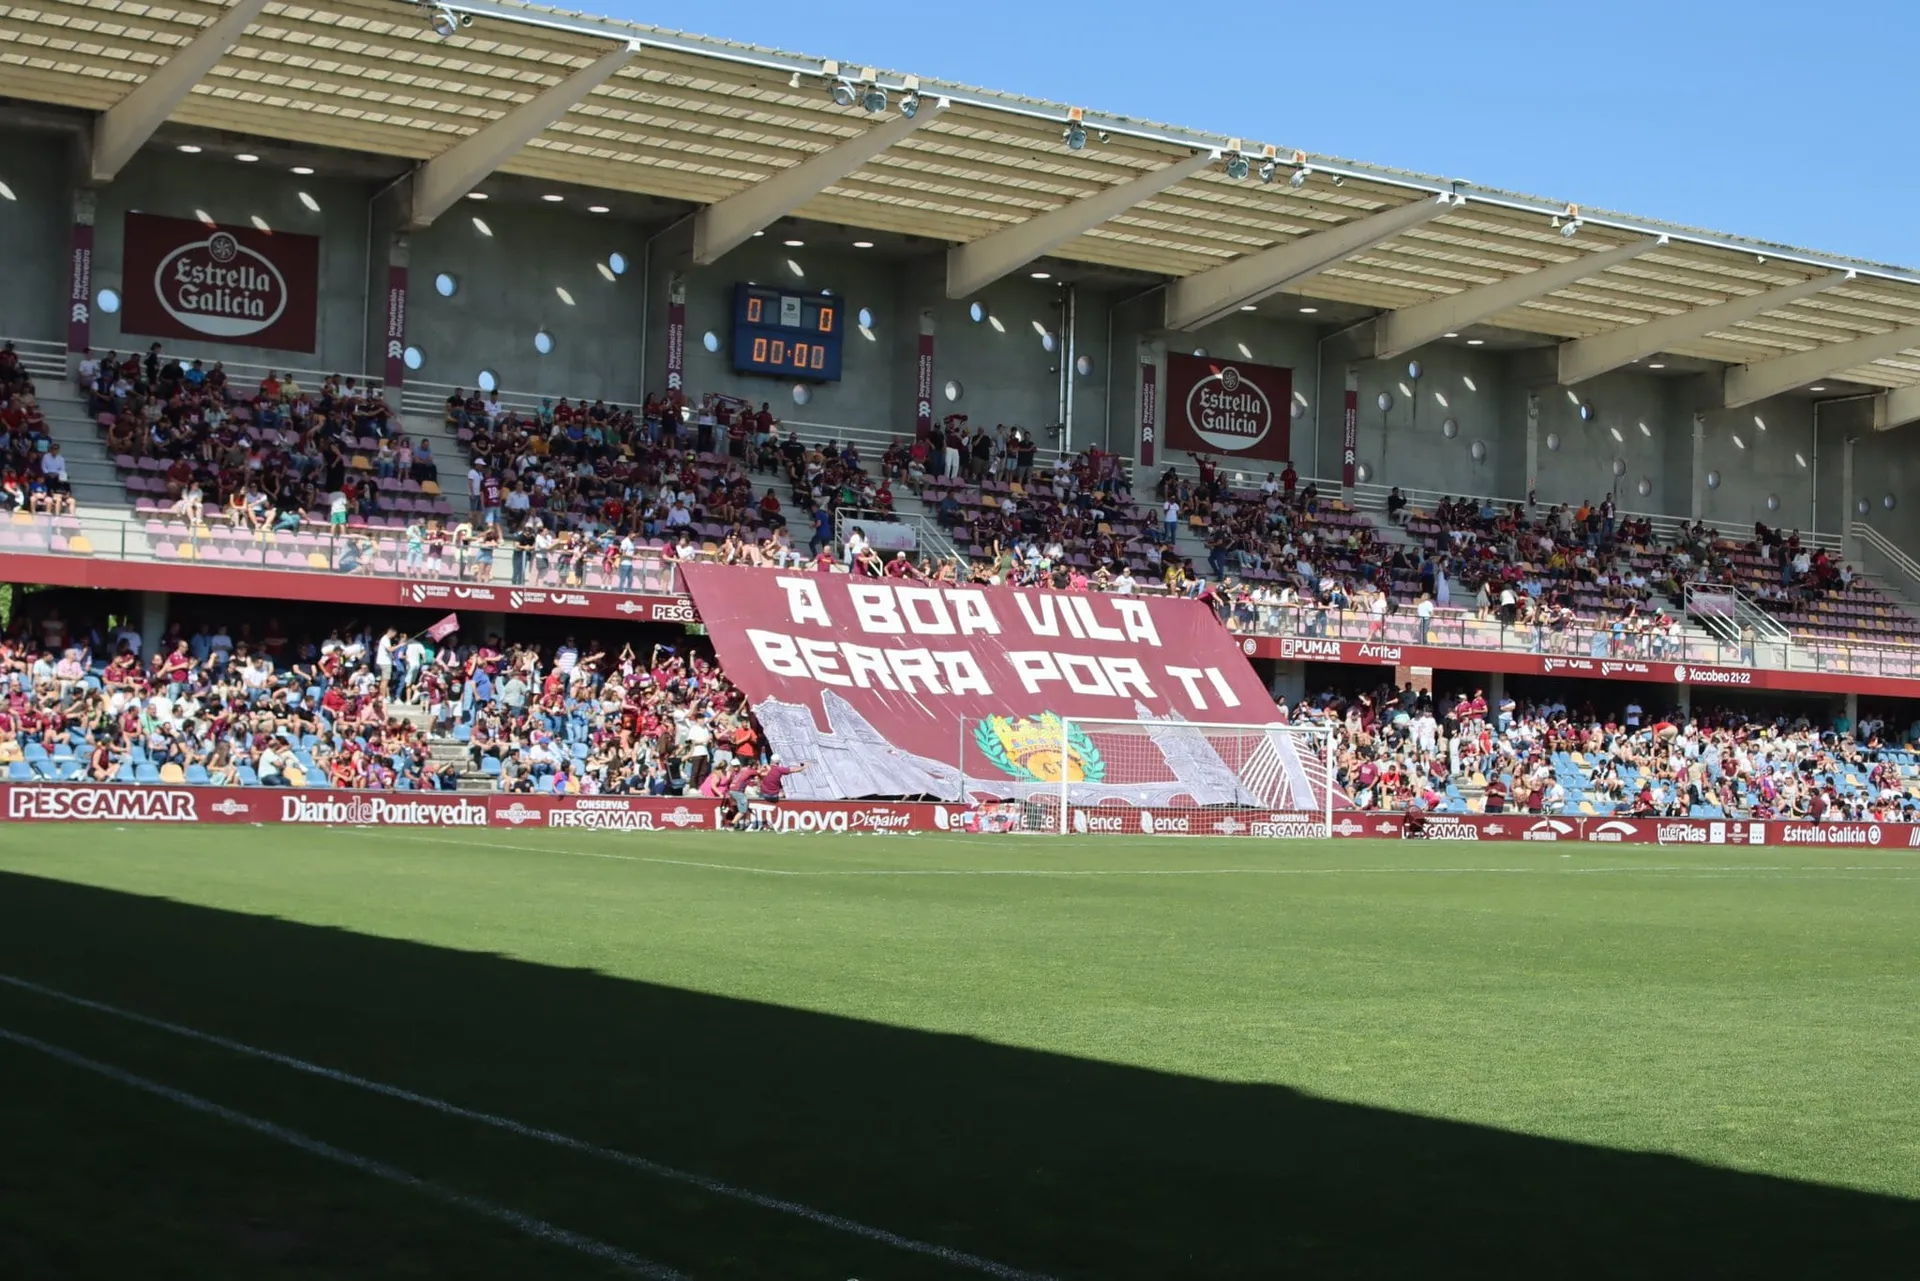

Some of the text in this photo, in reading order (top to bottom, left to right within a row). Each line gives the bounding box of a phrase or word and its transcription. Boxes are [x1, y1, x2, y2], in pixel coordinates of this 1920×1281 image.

[174, 257, 270, 292] Estrella
[178, 283, 265, 317] Galicia
[747, 298, 833, 332] 0 0
[1199, 387, 1260, 414] Estrella
[1201, 408, 1257, 434] Galicia
[777, 575, 1162, 647] A BOA VILA
[1294, 640, 1340, 655] PUMAR
[745, 628, 1241, 710] BERRA POR TI
[1689, 667, 1730, 682] Xacobeo
[9, 788, 199, 821] PESCAMAR
[576, 799, 630, 809] CONSERVAS
[549, 809, 654, 830] PESCAMAR
[851, 810, 910, 830] Dispaint
[1089, 815, 1122, 830] ence
[1270, 814, 1309, 823] CONSERVAS
[1250, 822, 1328, 839] PESCAMAR
[1783, 825, 1825, 843] Estrella
[1828, 825, 1866, 843] Galicia
